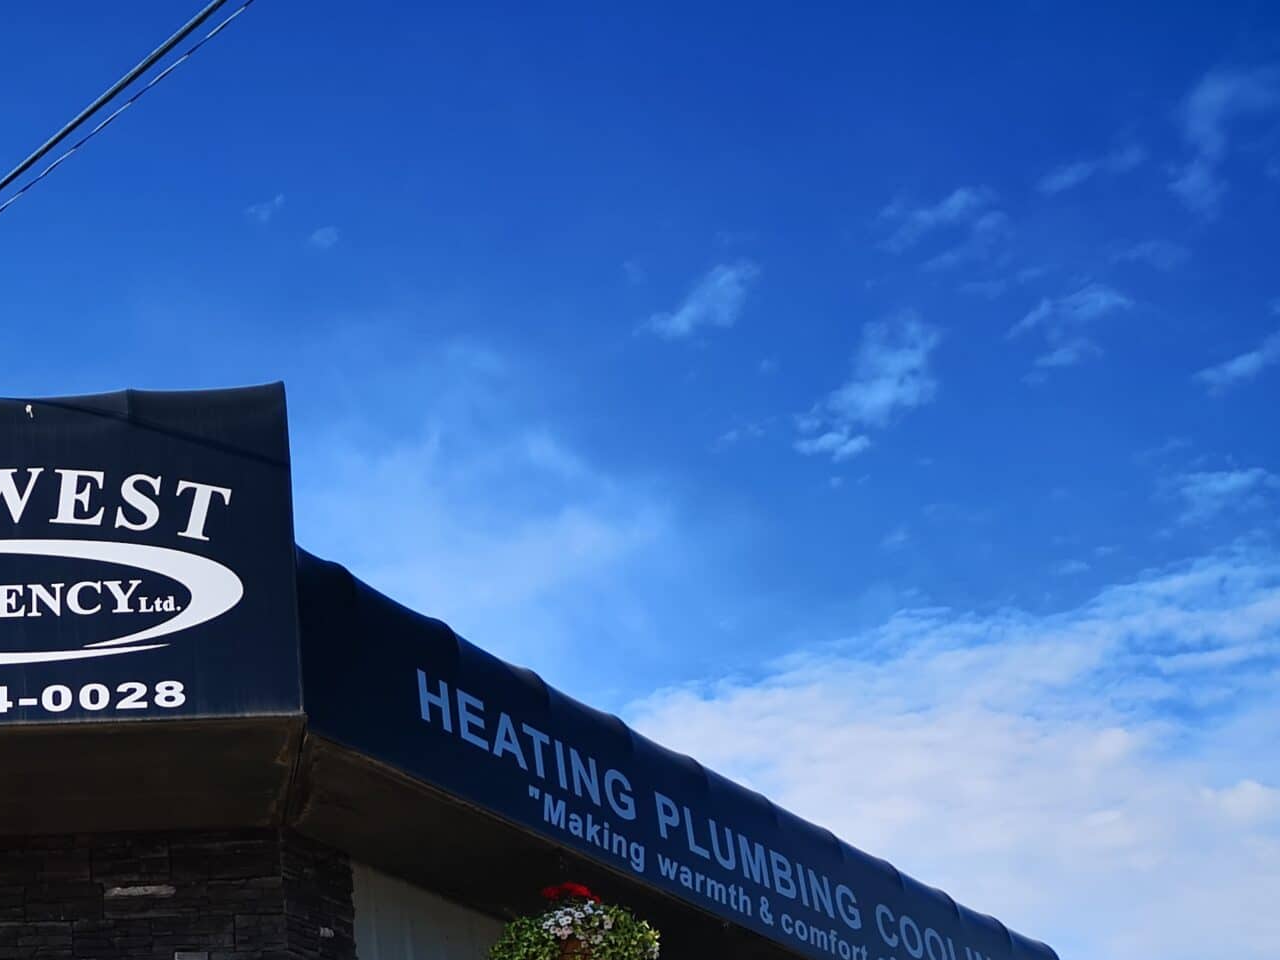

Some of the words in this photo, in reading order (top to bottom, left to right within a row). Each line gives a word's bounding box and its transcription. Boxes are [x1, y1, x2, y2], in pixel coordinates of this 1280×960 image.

[139, 594, 181, 614] Ltd.
[417, 668, 636, 820] HEATING
[654, 791, 862, 930] PLUMBING
[528, 785, 645, 872] "Making
[658, 852, 752, 917] warmth
[759, 897, 773, 926] &
